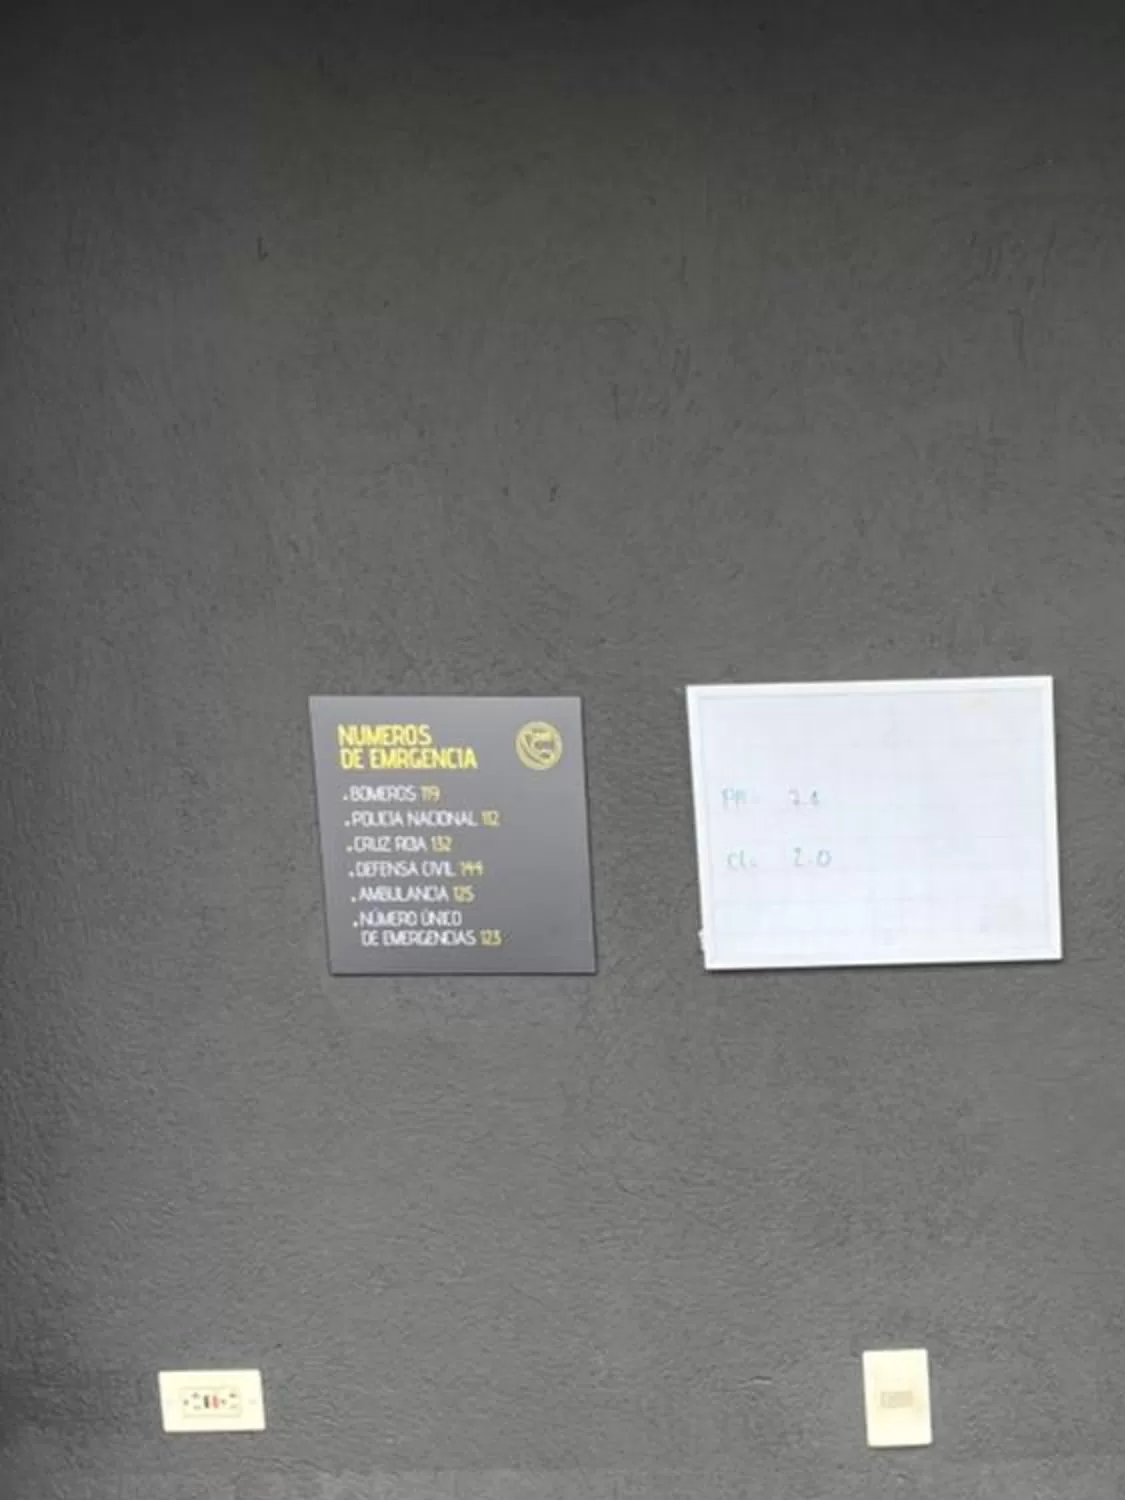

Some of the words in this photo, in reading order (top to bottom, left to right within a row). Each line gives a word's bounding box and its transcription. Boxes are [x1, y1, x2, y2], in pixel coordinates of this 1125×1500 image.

[337, 723, 433, 746] NUMEROS
[340, 747, 365, 769] DE
[407, 810, 479, 827] NACIONAL
[353, 835, 392, 853] CRUZ
[355, 860, 419, 877] DEFENSA
[421, 860, 456, 877] CIVIL
[358, 885, 449, 902] AMBULANCIA
[360, 930, 379, 947] DE
[381, 929, 477, 947] EMERGENCIAS
